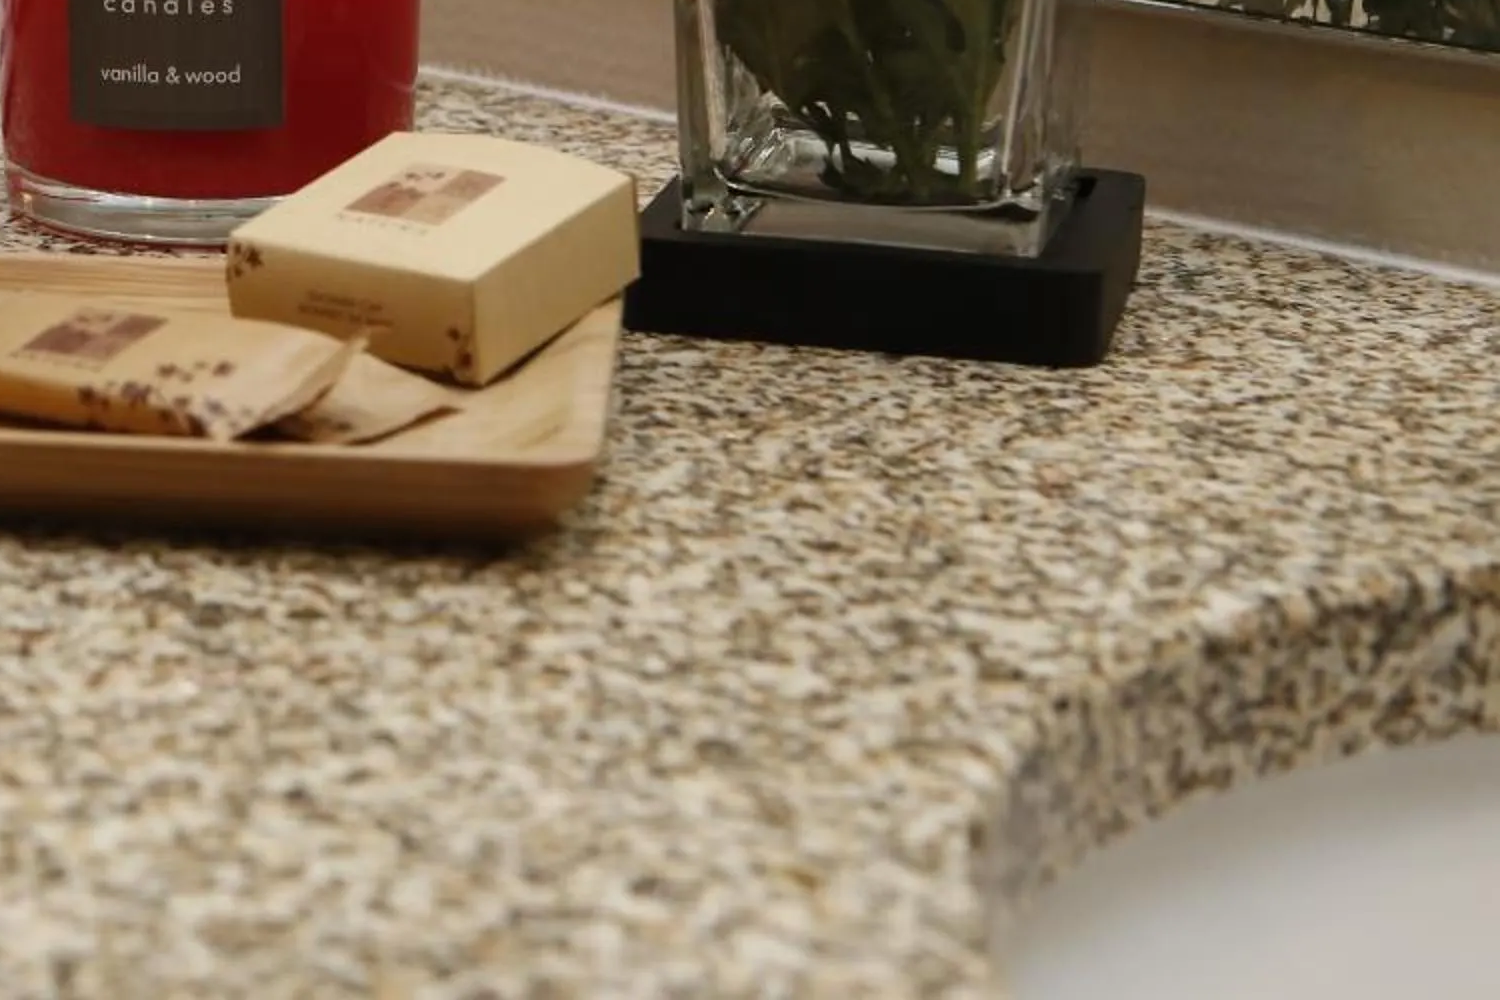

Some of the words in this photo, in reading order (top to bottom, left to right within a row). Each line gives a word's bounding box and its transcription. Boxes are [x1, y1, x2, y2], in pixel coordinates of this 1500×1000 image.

[101, 63, 159, 83] vanilla
[165, 65, 181, 84] &
[185, 64, 241, 83] wood
